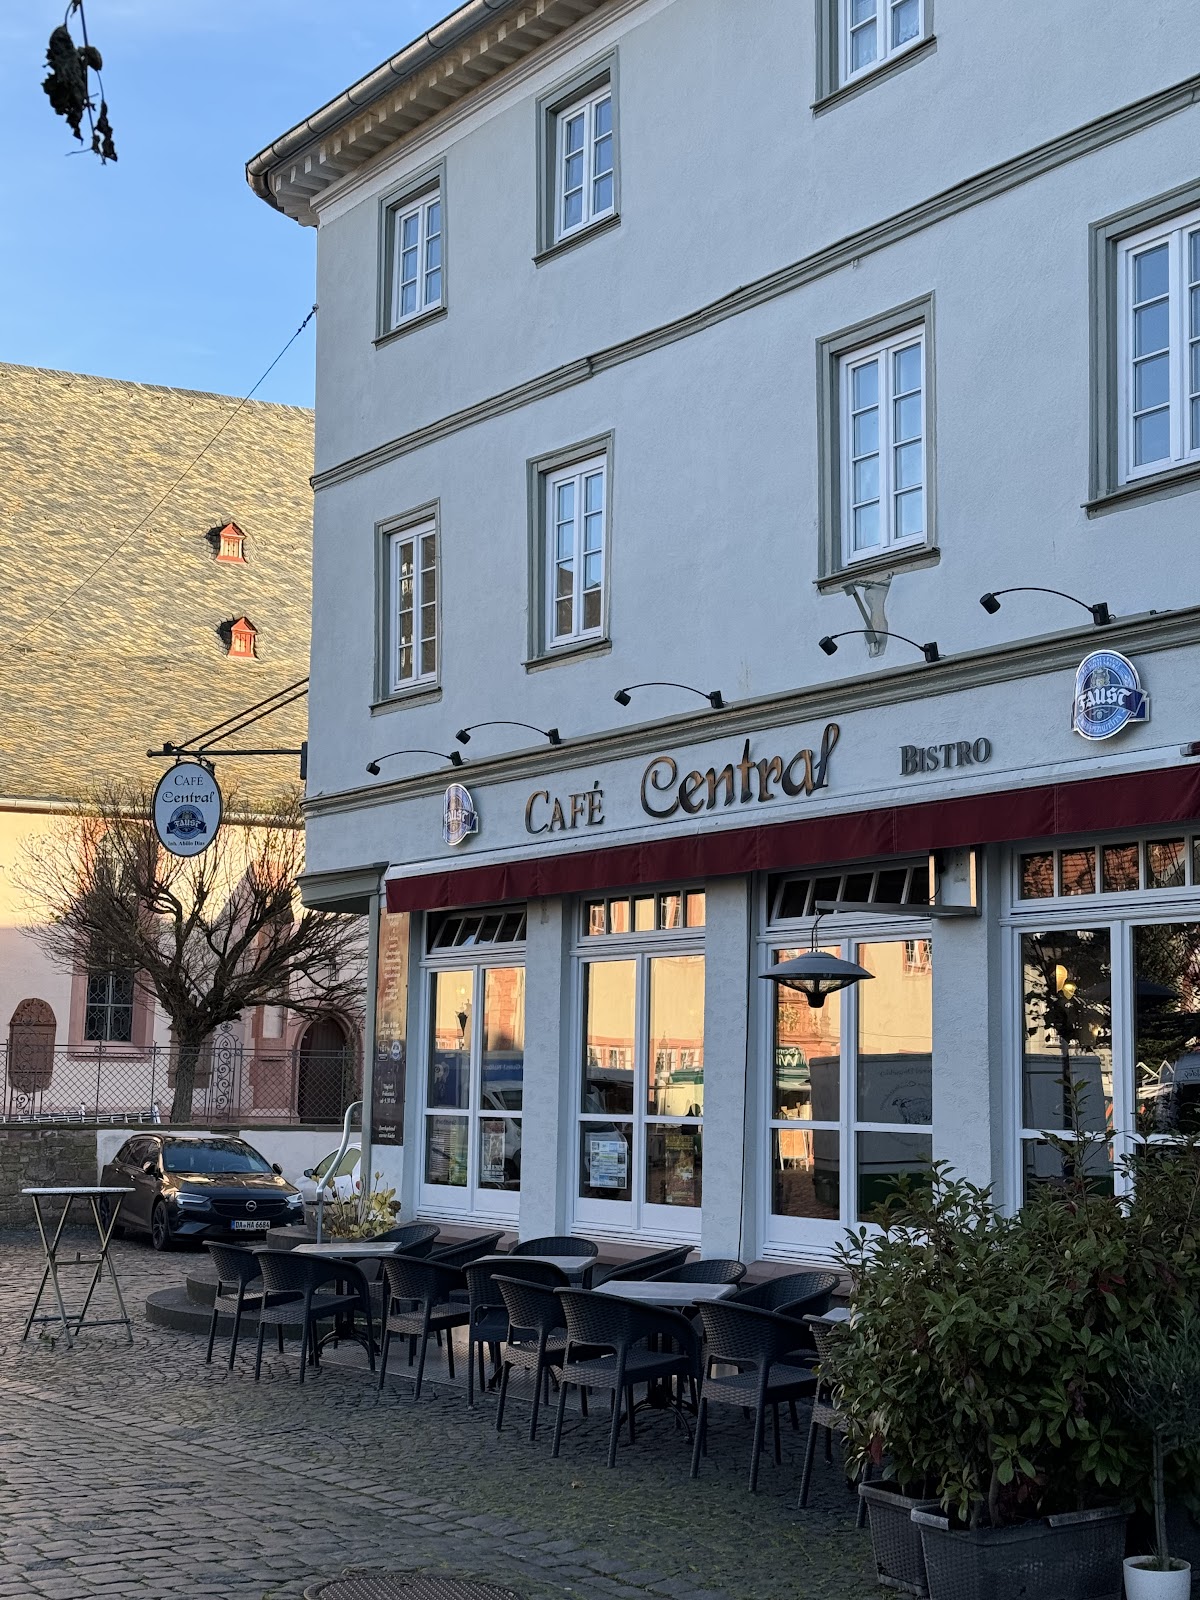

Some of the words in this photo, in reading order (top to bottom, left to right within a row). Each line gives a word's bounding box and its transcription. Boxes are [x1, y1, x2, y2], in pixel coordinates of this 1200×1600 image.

[1078, 687, 1132, 712] FAUST
[899, 737, 992, 777] BISTRO
[174, 774, 204, 786] CAFÉ
[524, 780, 605, 835] CAFÉ
[640, 722, 840, 818] Central
[162, 791, 215, 803] Central
[174, 819, 202, 828] FAUST
